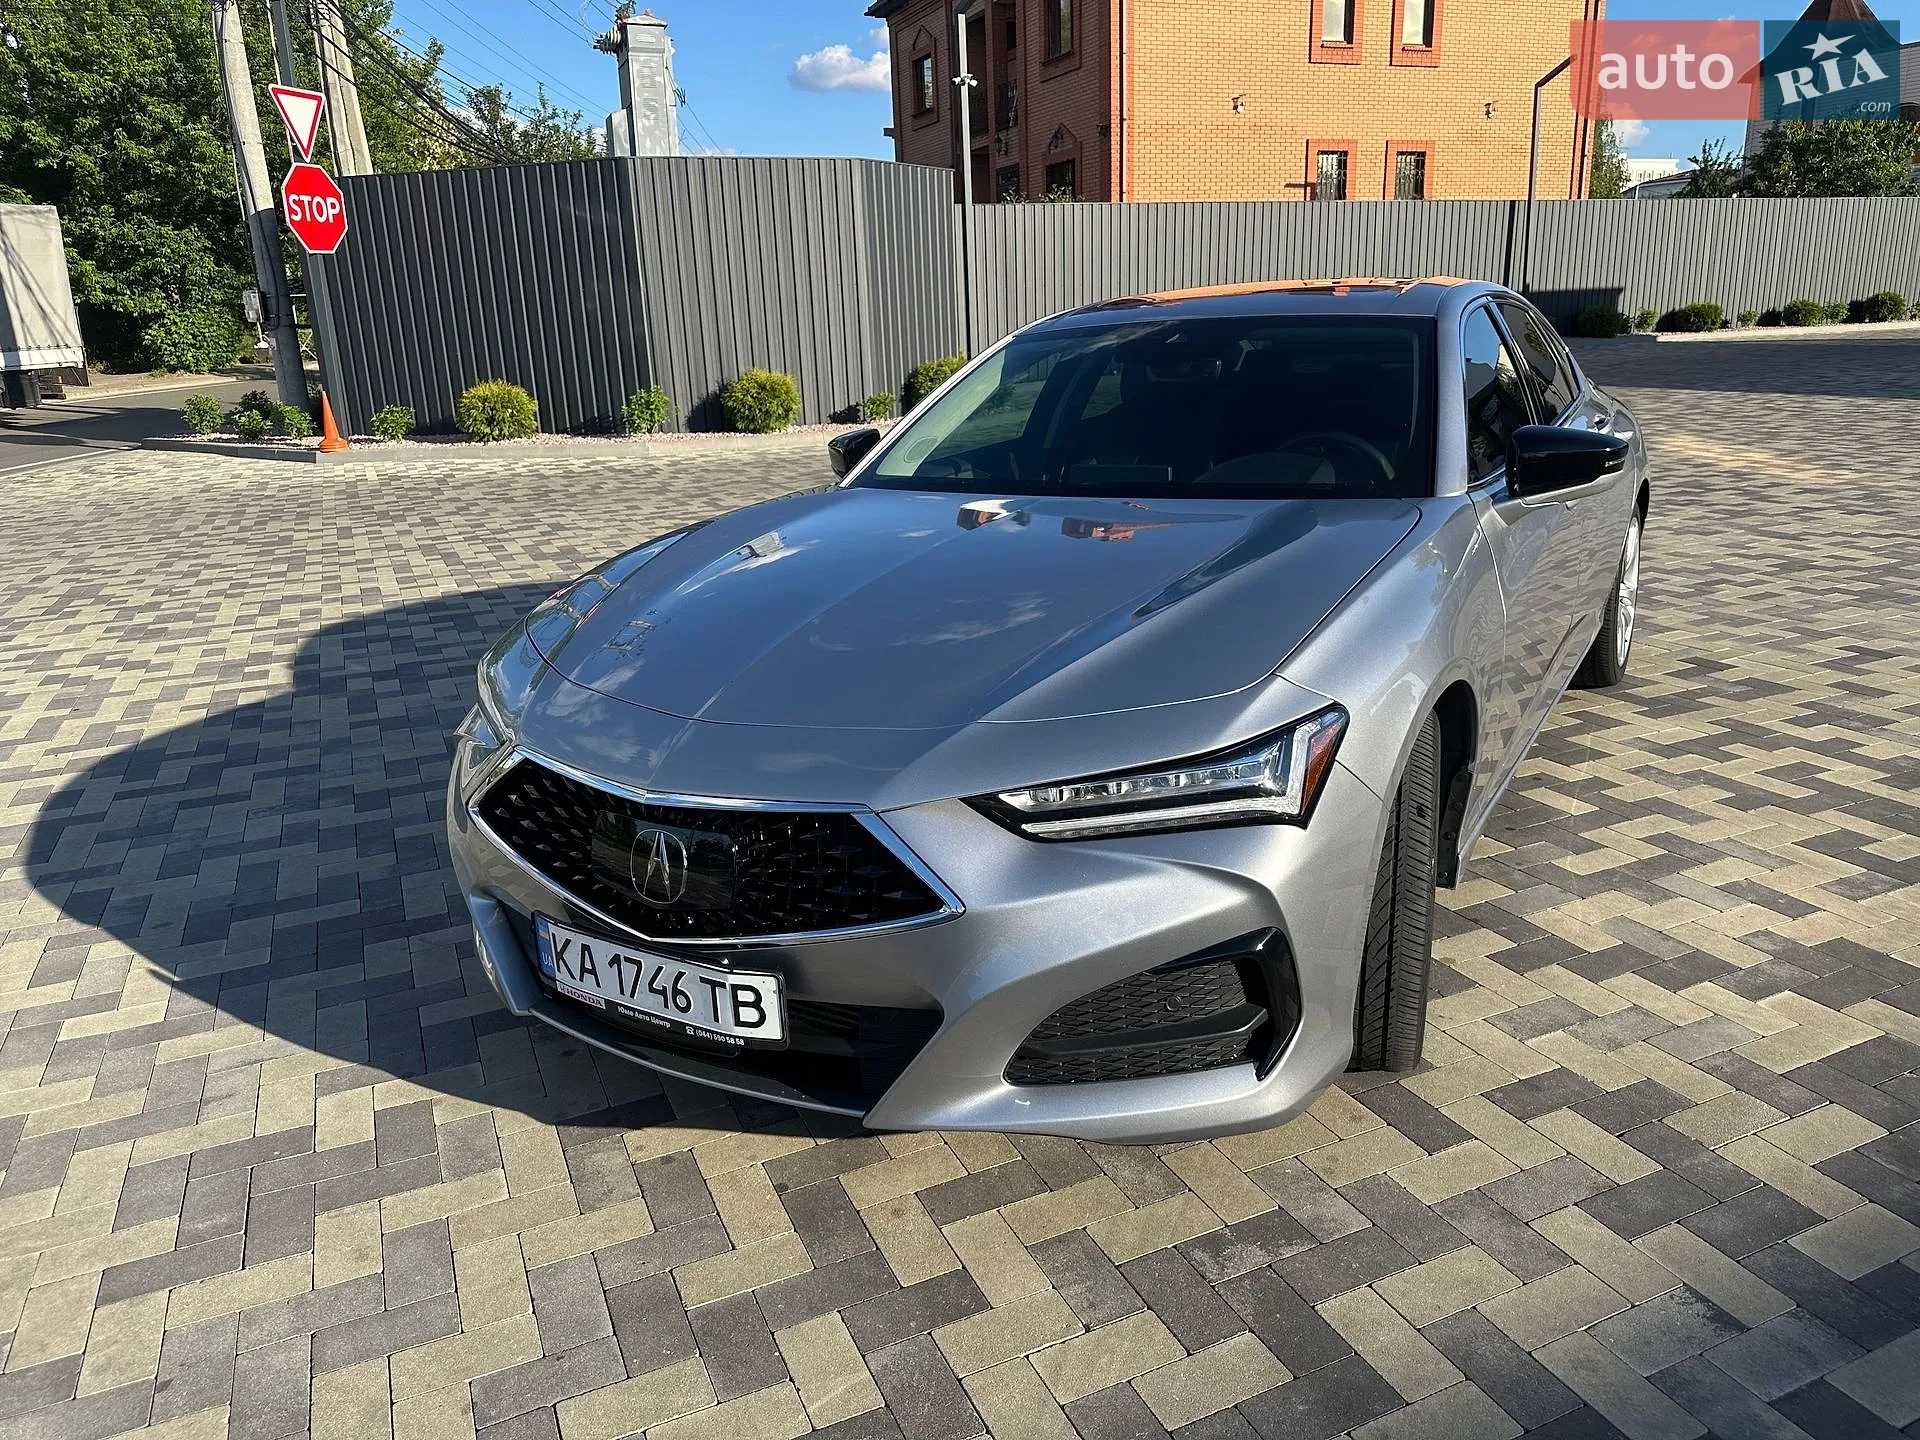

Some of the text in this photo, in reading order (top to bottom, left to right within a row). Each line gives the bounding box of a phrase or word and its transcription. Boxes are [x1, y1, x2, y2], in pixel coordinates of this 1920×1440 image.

[289, 194, 341, 223] STOP
[541, 951, 554, 968] UA
[551, 932, 767, 1028] KA 1746 TB
[564, 987, 604, 1007] HONDA
[695, 1029, 713, 1040] (044)
